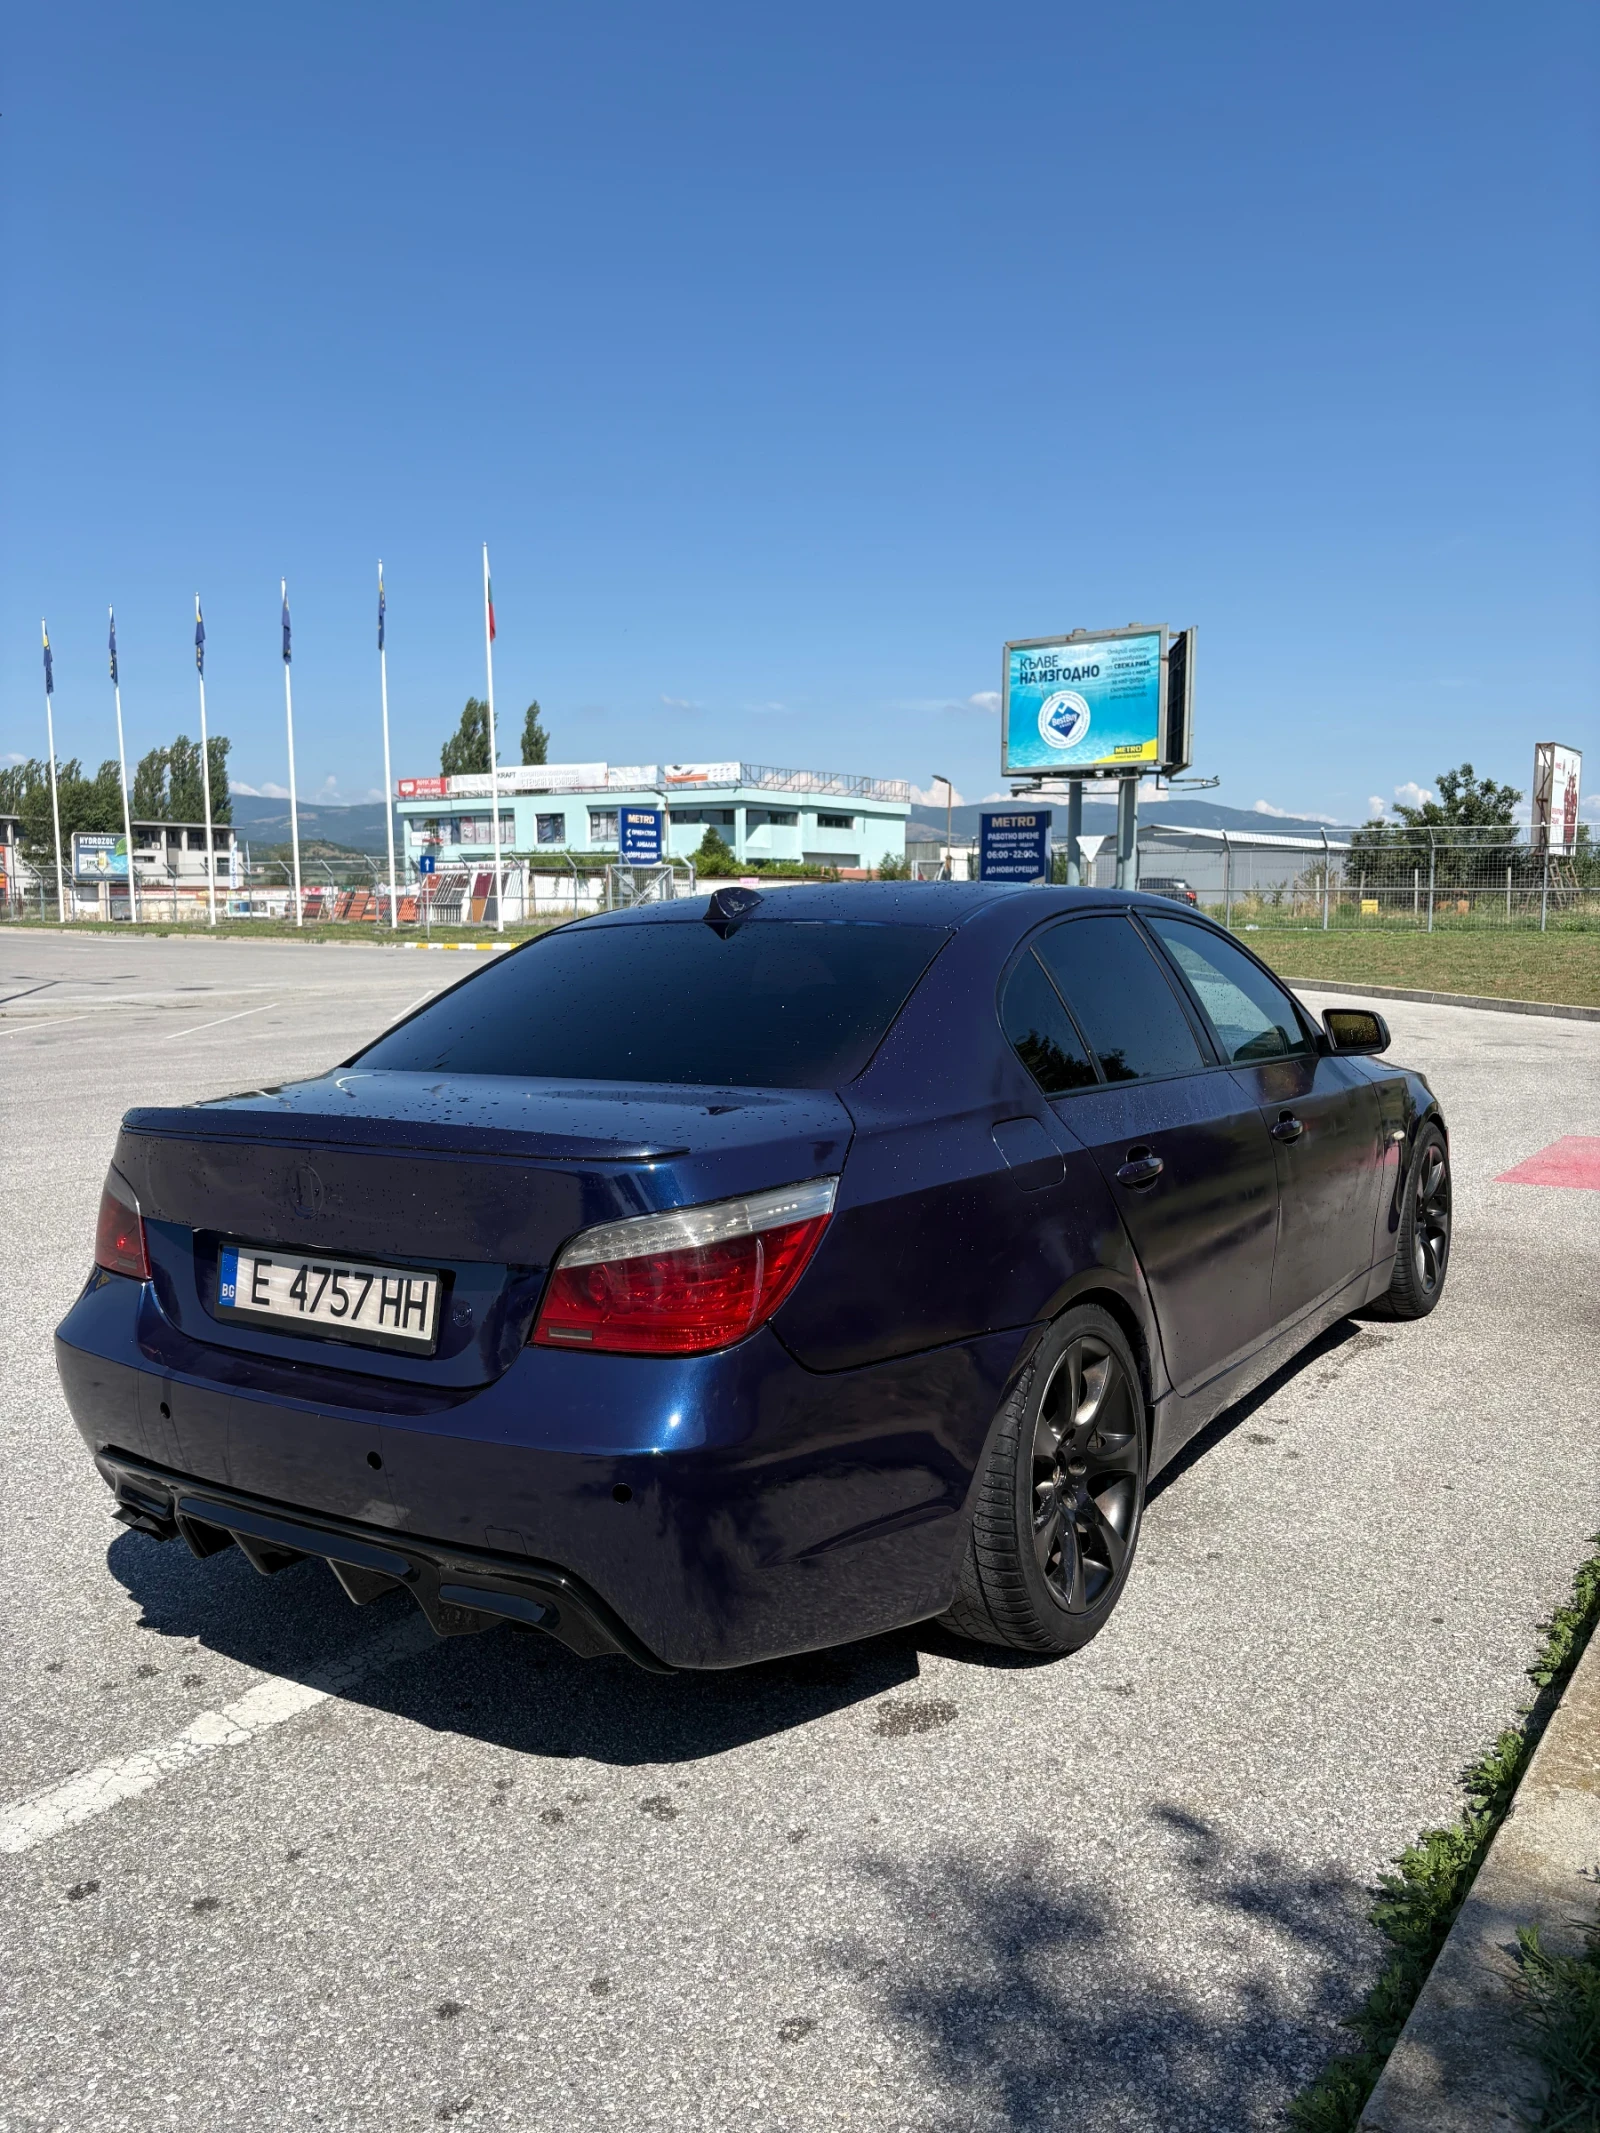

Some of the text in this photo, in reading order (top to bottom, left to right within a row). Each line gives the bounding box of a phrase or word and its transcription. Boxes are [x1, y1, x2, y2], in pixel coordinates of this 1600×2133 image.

[1020, 655, 1059, 671] КЪЛВЕ
[1020, 665, 1100, 685] НА ИЗГОДНО
[1115, 745, 1142, 754] METRO
[628, 814, 655, 825] METRO
[992, 816, 1036, 828] METRO
[987, 831, 1040, 841] РАБОТНО ВРЕМЕ
[986, 850, 1009, 859] 06:00
[986, 865, 1039, 875] ДО НОВИ СРЕЩИ!
[251, 1257, 273, 1306] E
[221, 1282, 235, 1299] BG
